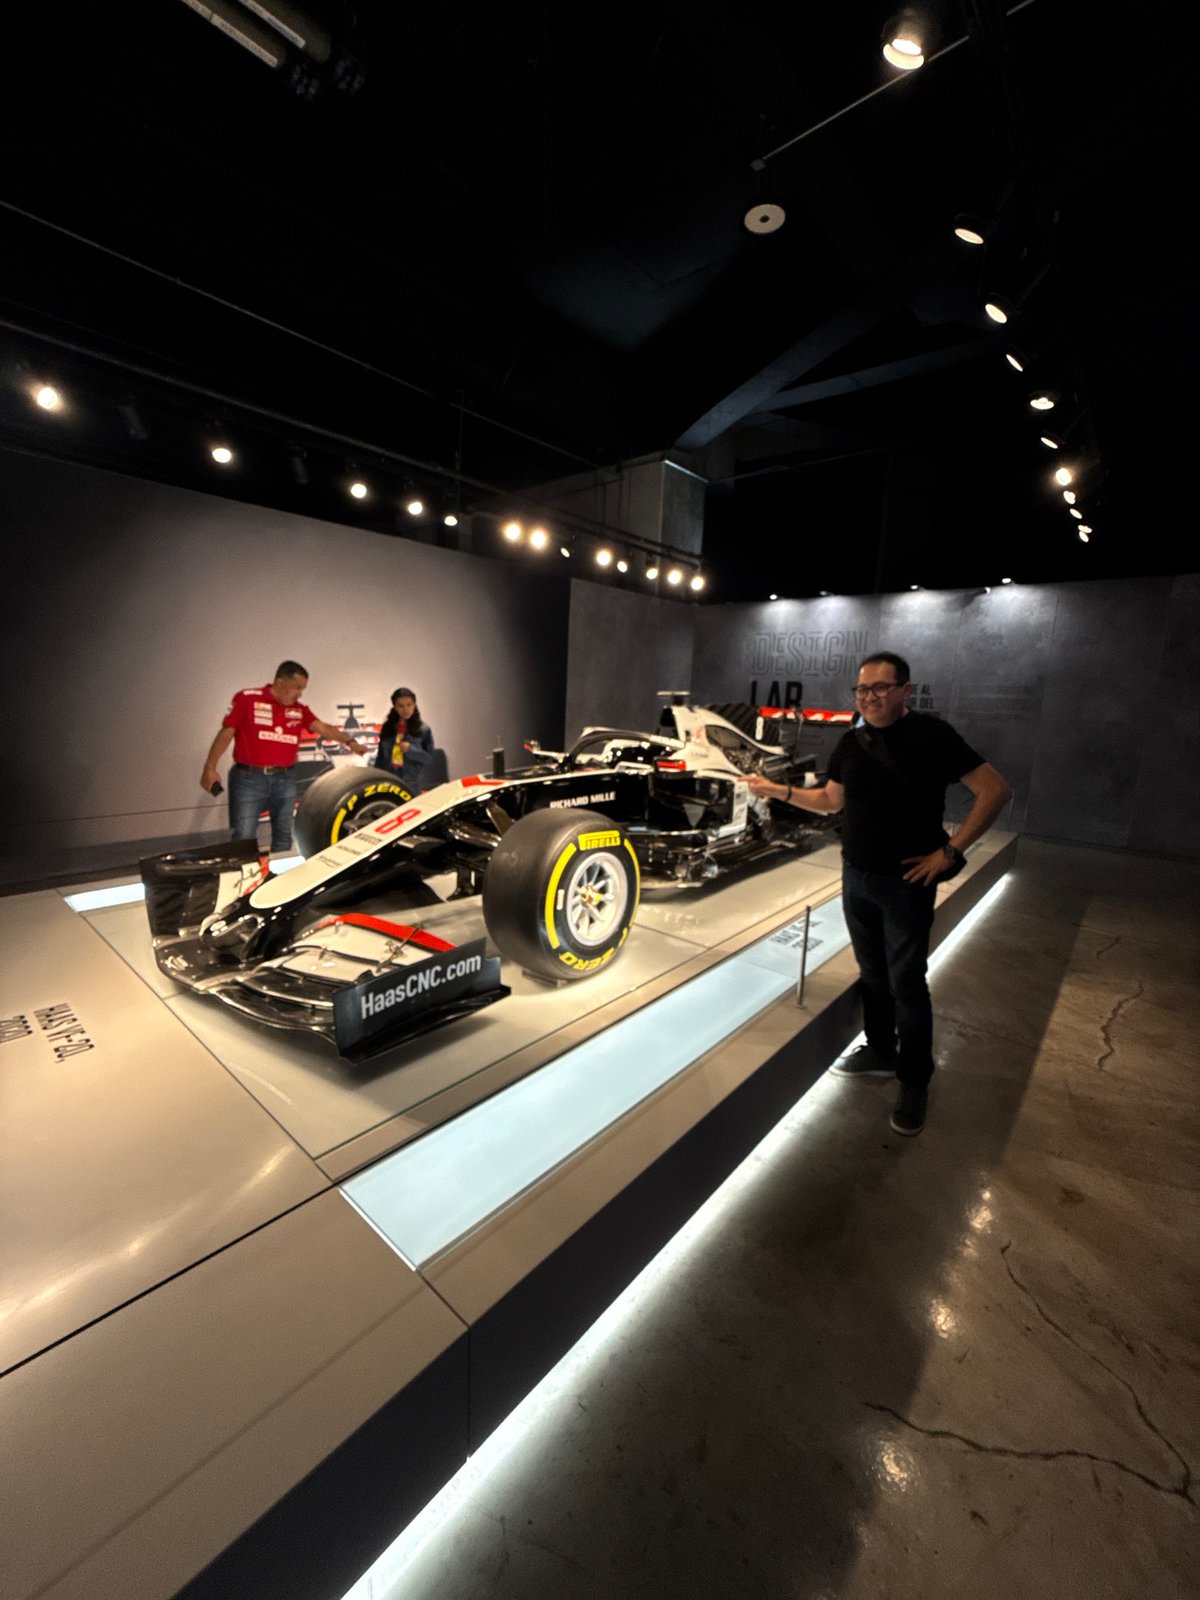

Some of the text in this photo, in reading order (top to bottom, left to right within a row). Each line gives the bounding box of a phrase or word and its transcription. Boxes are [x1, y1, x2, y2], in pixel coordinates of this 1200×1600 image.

[752, 631, 869, 677] DESIGN
[363, 782, 413, 802] ZERO
[549, 791, 616, 809] RICHARD MILLE
[374, 808, 421, 835] 8
[578, 829, 620, 851] PIRELLI
[361, 954, 482, 1020] HaasCNC.com
[32, 1001, 78, 1031] HAAS
